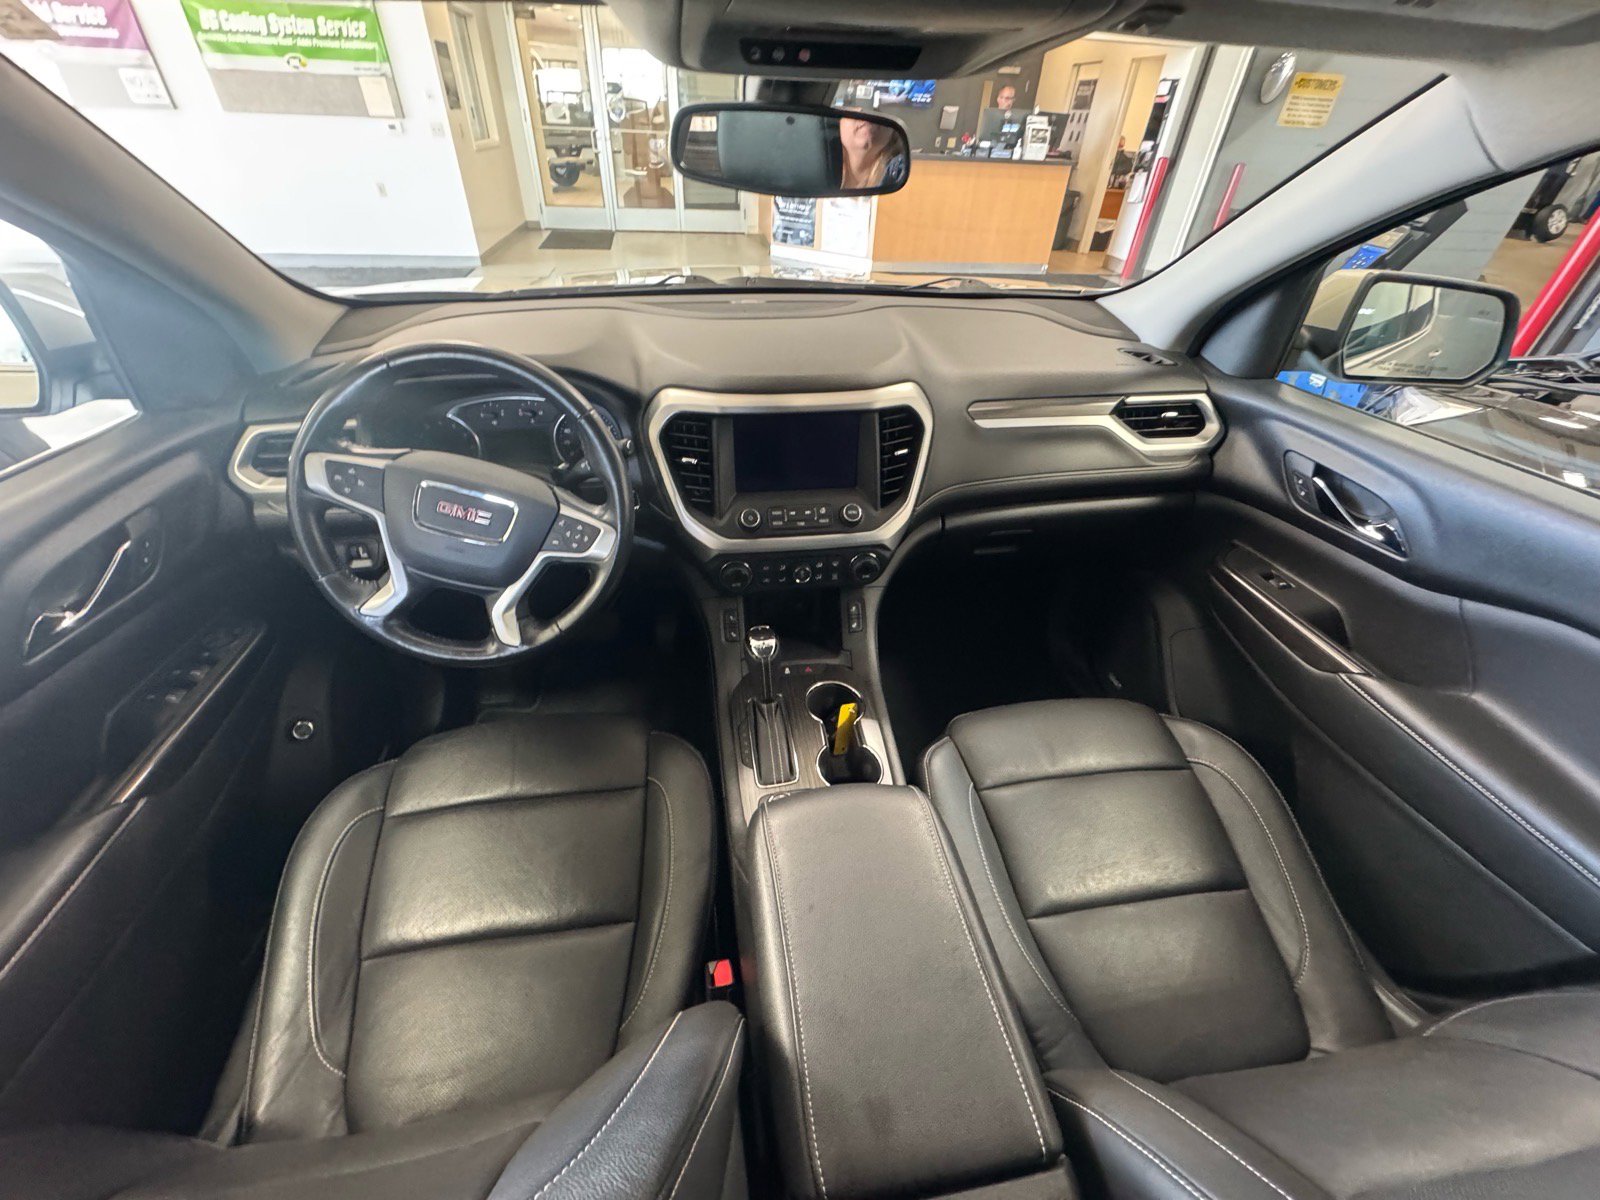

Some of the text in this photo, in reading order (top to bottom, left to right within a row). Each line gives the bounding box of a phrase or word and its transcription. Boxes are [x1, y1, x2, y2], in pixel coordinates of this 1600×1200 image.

[219, 9, 267, 36] Cooling
[267, 12, 316, 38] System
[316, 15, 367, 38] Service
[436, 500, 493, 526] GMC
